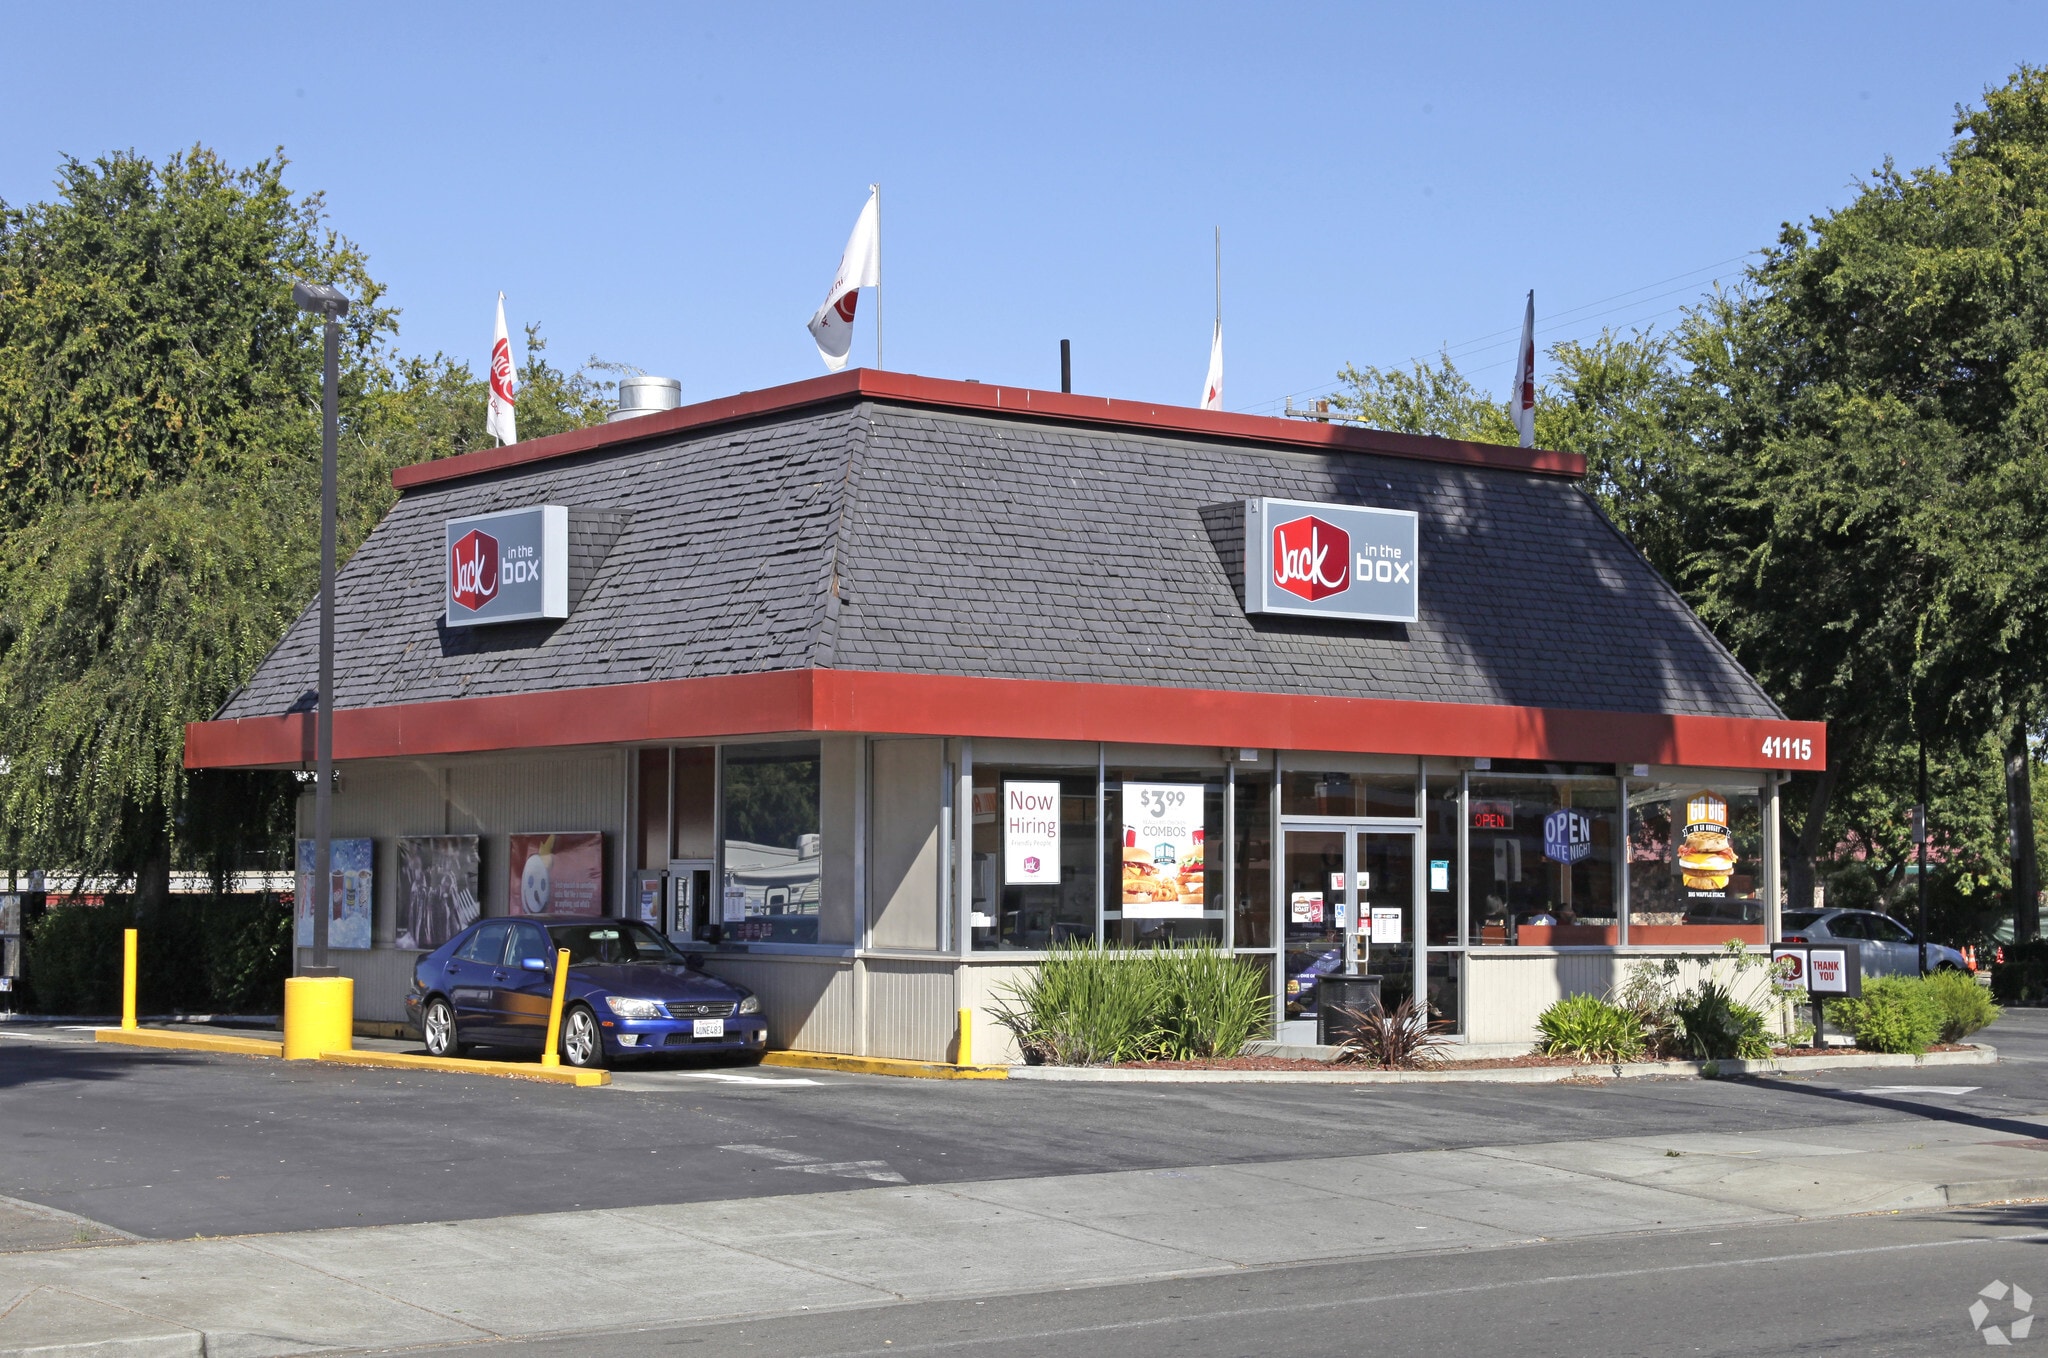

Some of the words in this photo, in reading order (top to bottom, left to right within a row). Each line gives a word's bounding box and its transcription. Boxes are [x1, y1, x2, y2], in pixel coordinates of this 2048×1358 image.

[507, 547, 517, 559] in
[518, 544, 533, 557] the
[1275, 526, 1347, 588] Jack
[1365, 542, 1377, 557] in
[1380, 544, 1402, 559] the
[453, 538, 496, 598] Jack
[502, 557, 539, 585] box
[1356, 552, 1410, 585] box
[1761, 736, 1812, 761] 41115
[1011, 790, 1053, 811] Now
[1690, 796, 1706, 821] GO
[1708, 796, 1725, 822] BIG
[1010, 817, 1056, 838] Hiring
[1142, 825, 1187, 837] COMBOS
[1475, 813, 1505, 828] OPEN
[1545, 812, 1590, 843] OPEN
[1546, 844, 1568, 861] LATE
[1569, 842, 1591, 861] NIGHT
[1813, 960, 1840, 971] THANK
[1819, 971, 1835, 982] YOU
